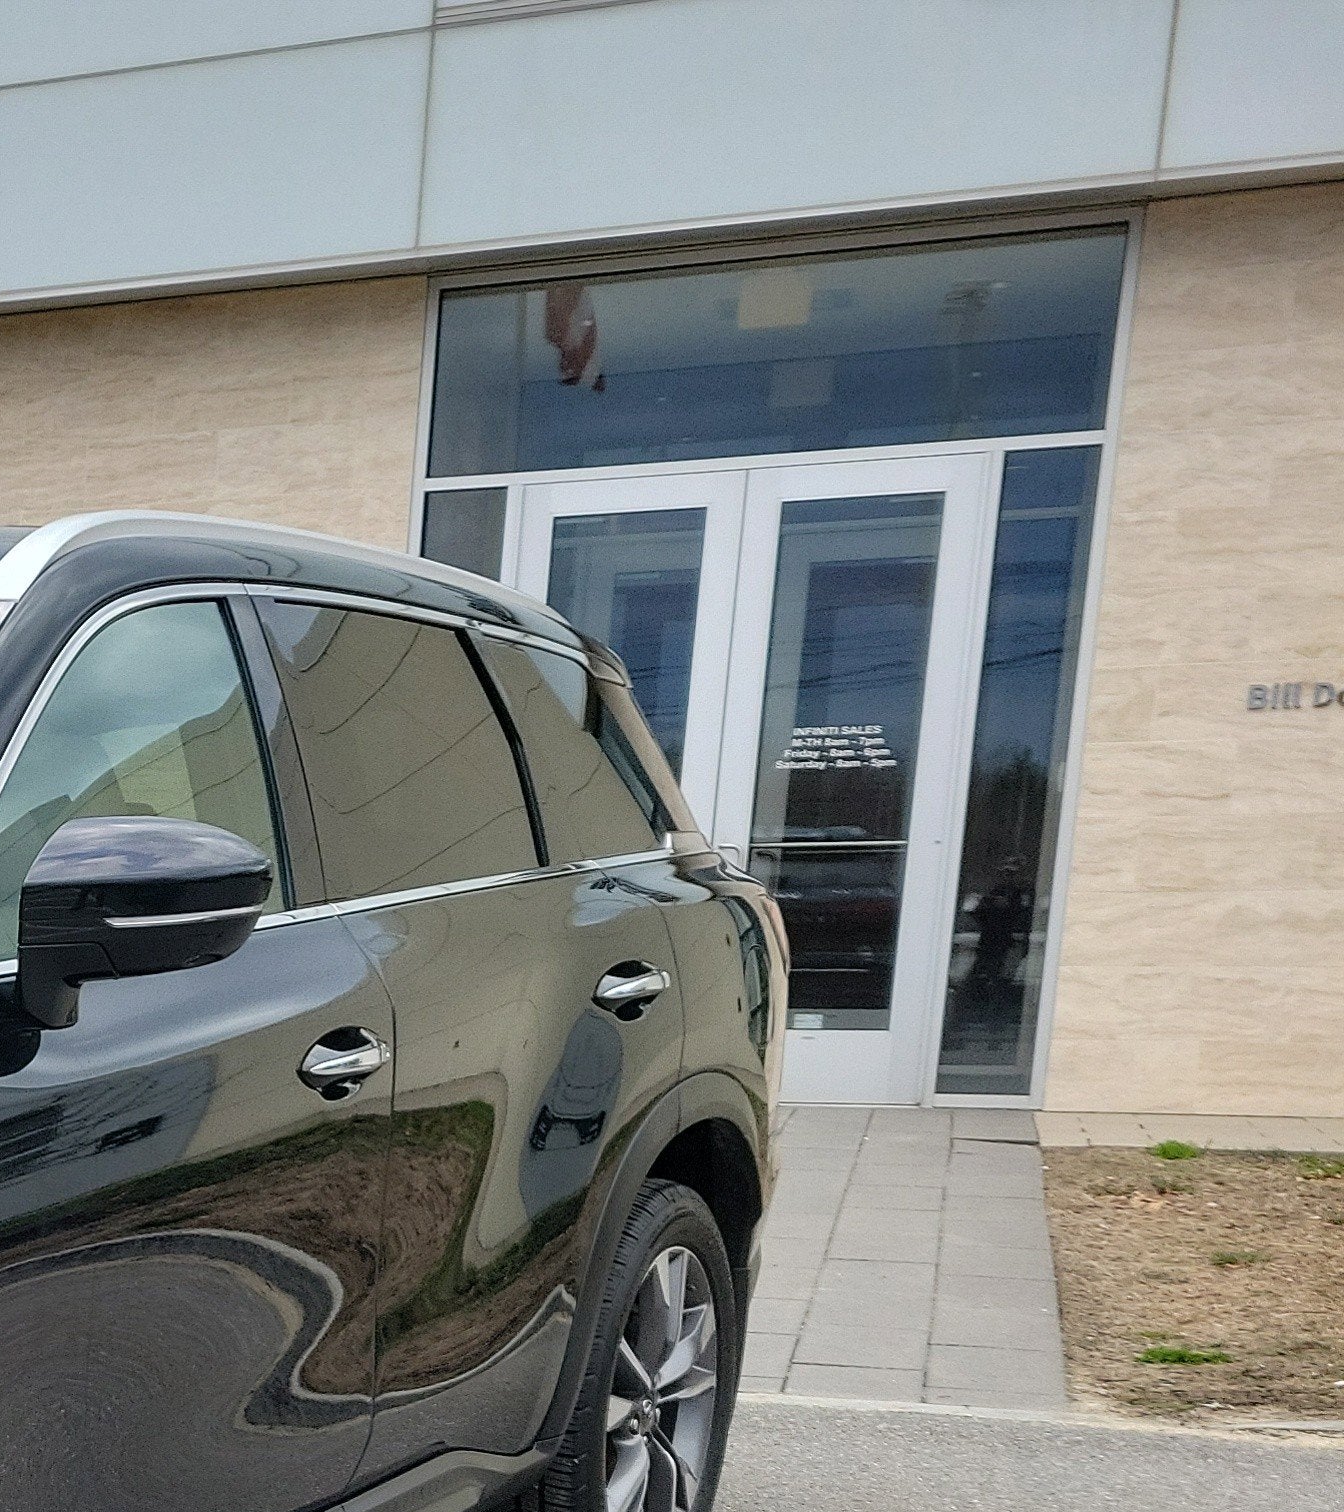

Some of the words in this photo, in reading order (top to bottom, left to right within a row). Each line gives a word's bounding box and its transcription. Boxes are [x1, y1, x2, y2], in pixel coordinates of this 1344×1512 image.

[1247, 682, 1301, 711] Bill
[792, 727, 839, 736] INFINITI
[840, 725, 882, 735] SALES
[783, 748, 820, 759] Friday
[775, 760, 827, 770] Saturday
